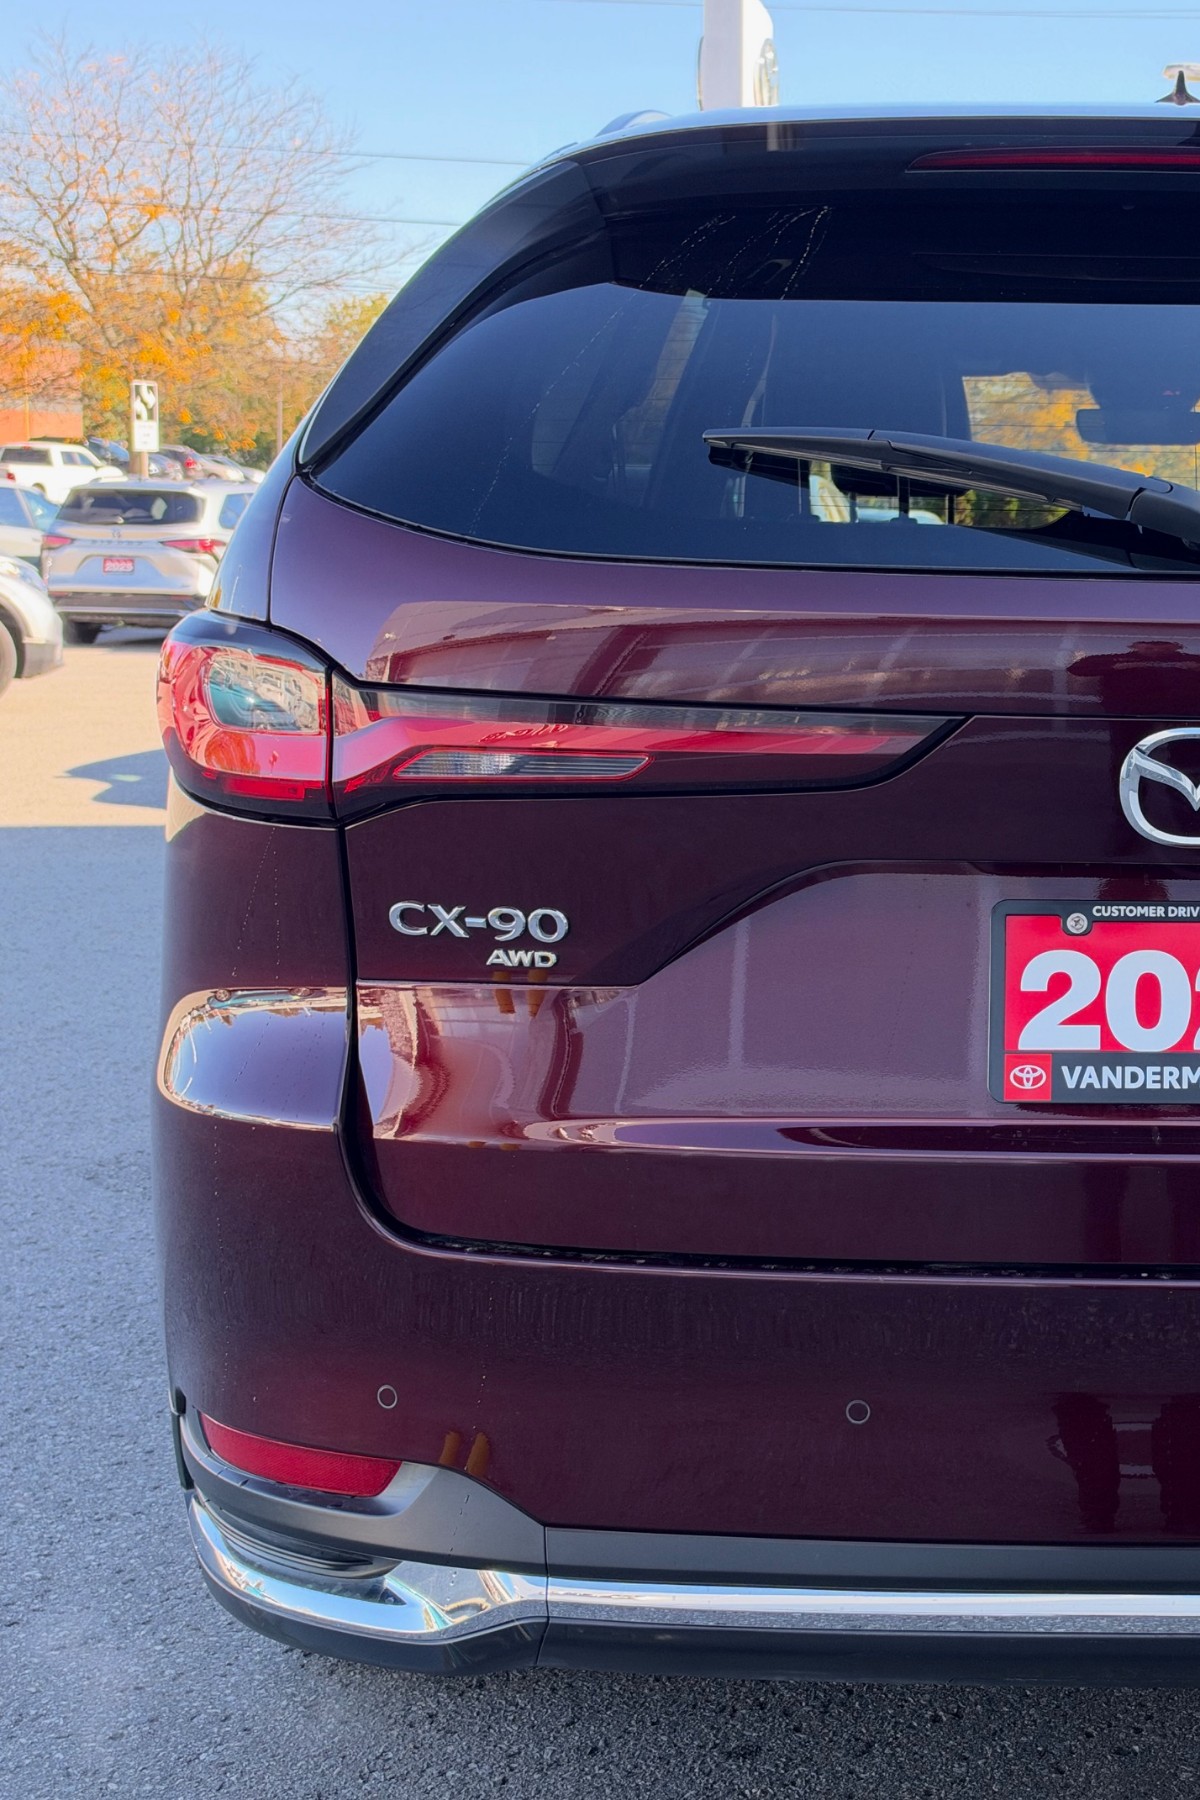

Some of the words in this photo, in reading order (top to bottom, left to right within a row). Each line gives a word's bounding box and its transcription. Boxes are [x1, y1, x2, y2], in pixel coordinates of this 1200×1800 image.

[388, 900, 569, 943] CX-90
[1092, 905, 1165, 918] CUSTOMER
[486, 948, 557, 968] AWD
